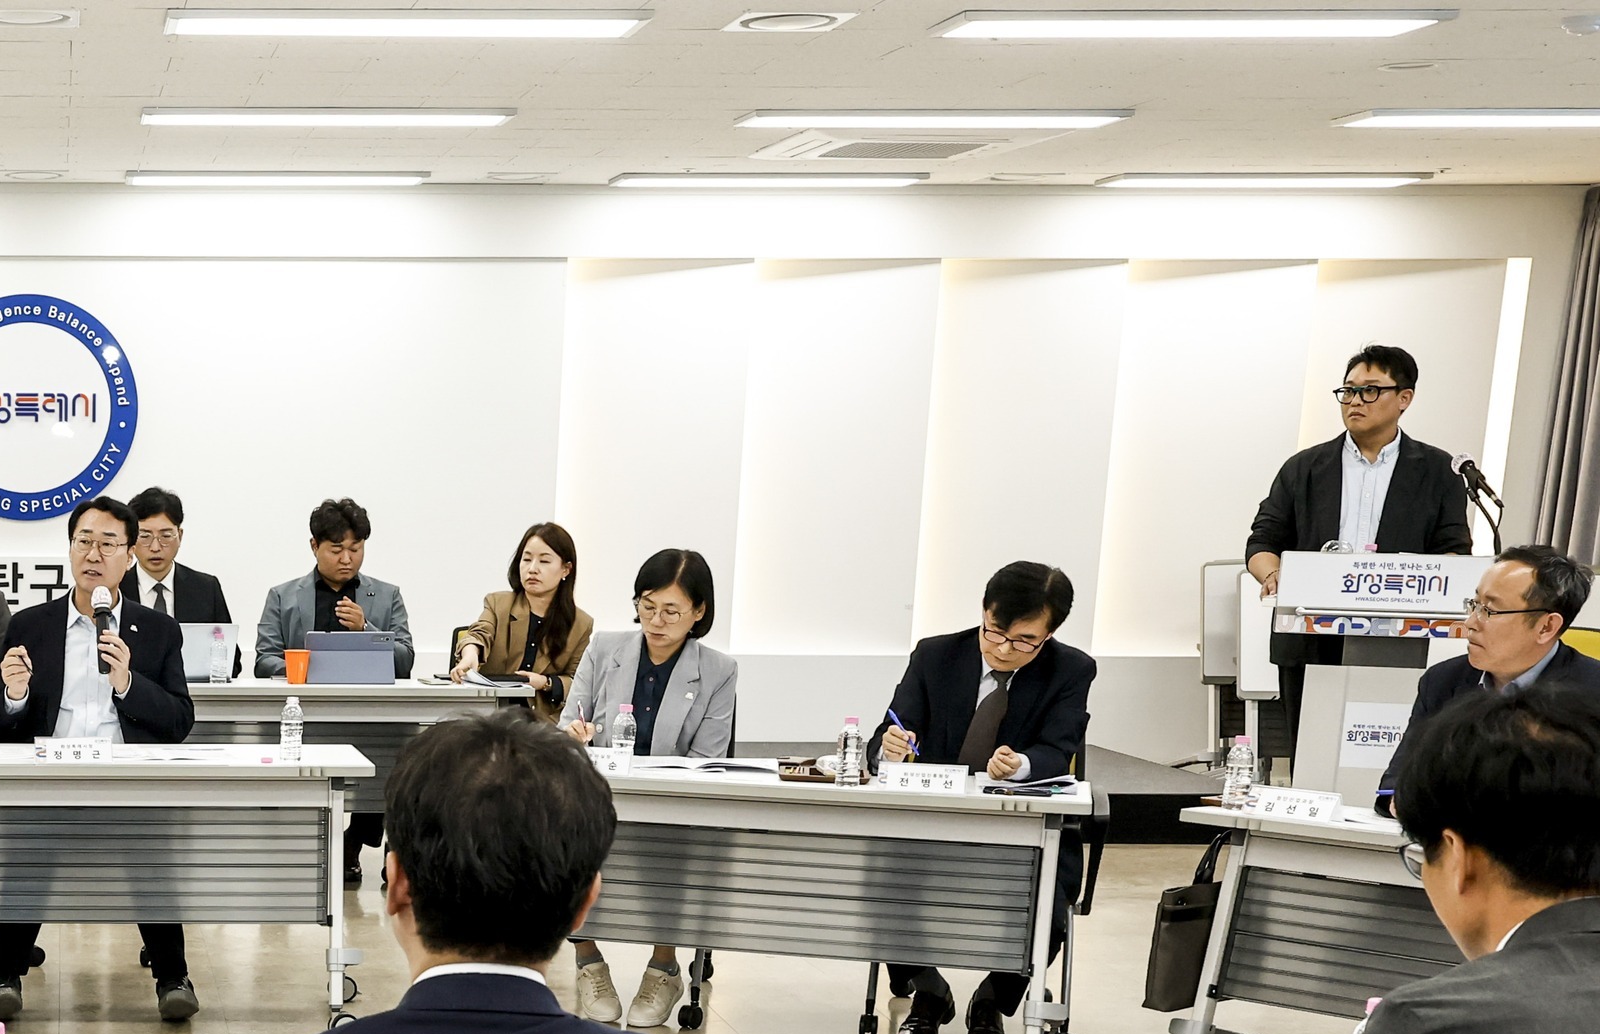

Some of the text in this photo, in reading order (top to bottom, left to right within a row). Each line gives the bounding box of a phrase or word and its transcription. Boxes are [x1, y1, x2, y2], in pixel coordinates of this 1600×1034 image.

[48, 305, 103, 347] Balance
[103, 347, 130, 407] xpand
[19, 481, 92, 513] SPECIAL
[92, 443, 122, 481] CITY
[1341, 573, 1449, 597] 화성특례시
[1353, 561, 1377, 570] 특별한
[1425, 563, 1442, 572] 도시
